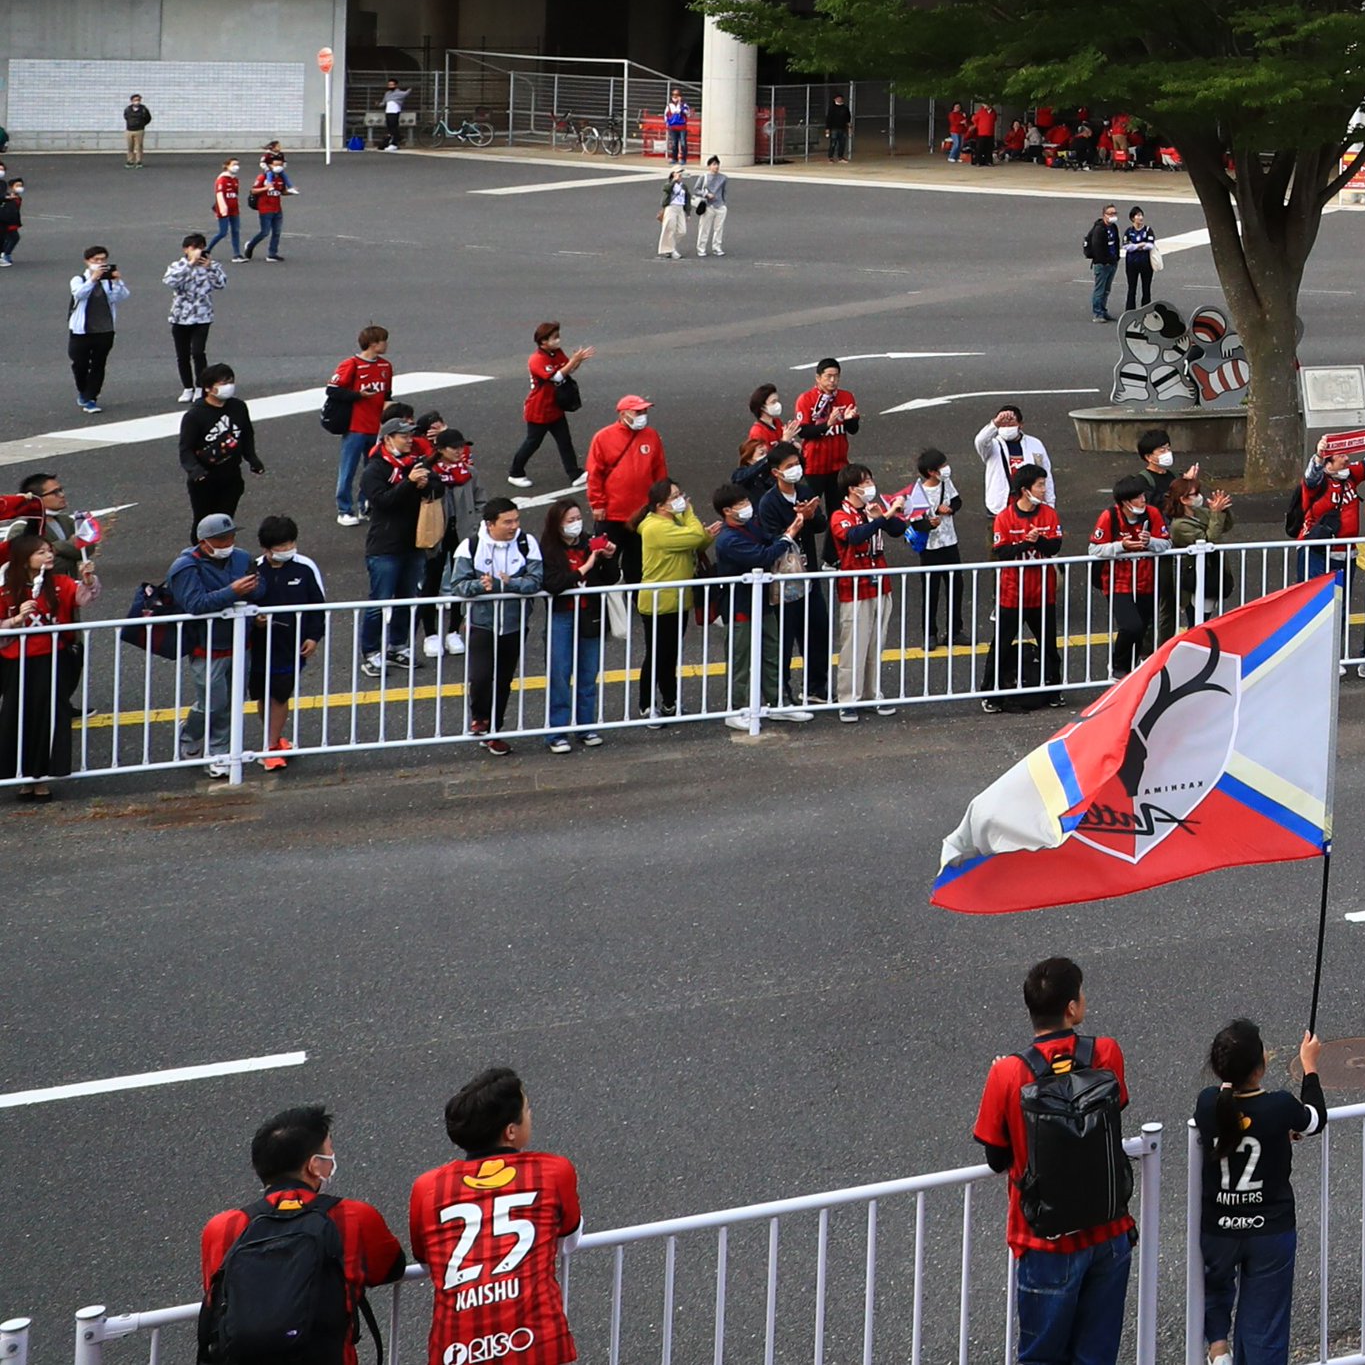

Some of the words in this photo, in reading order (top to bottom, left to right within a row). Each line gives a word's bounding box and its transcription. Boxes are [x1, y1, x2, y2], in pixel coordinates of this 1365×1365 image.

[1213, 1136, 1264, 1191] 12
[1216, 1191, 1263, 1205] ANTLERS
[440, 1191, 538, 1290] 25
[456, 1278, 520, 1311] KAISHU
[469, 1327, 535, 1364] RISO
